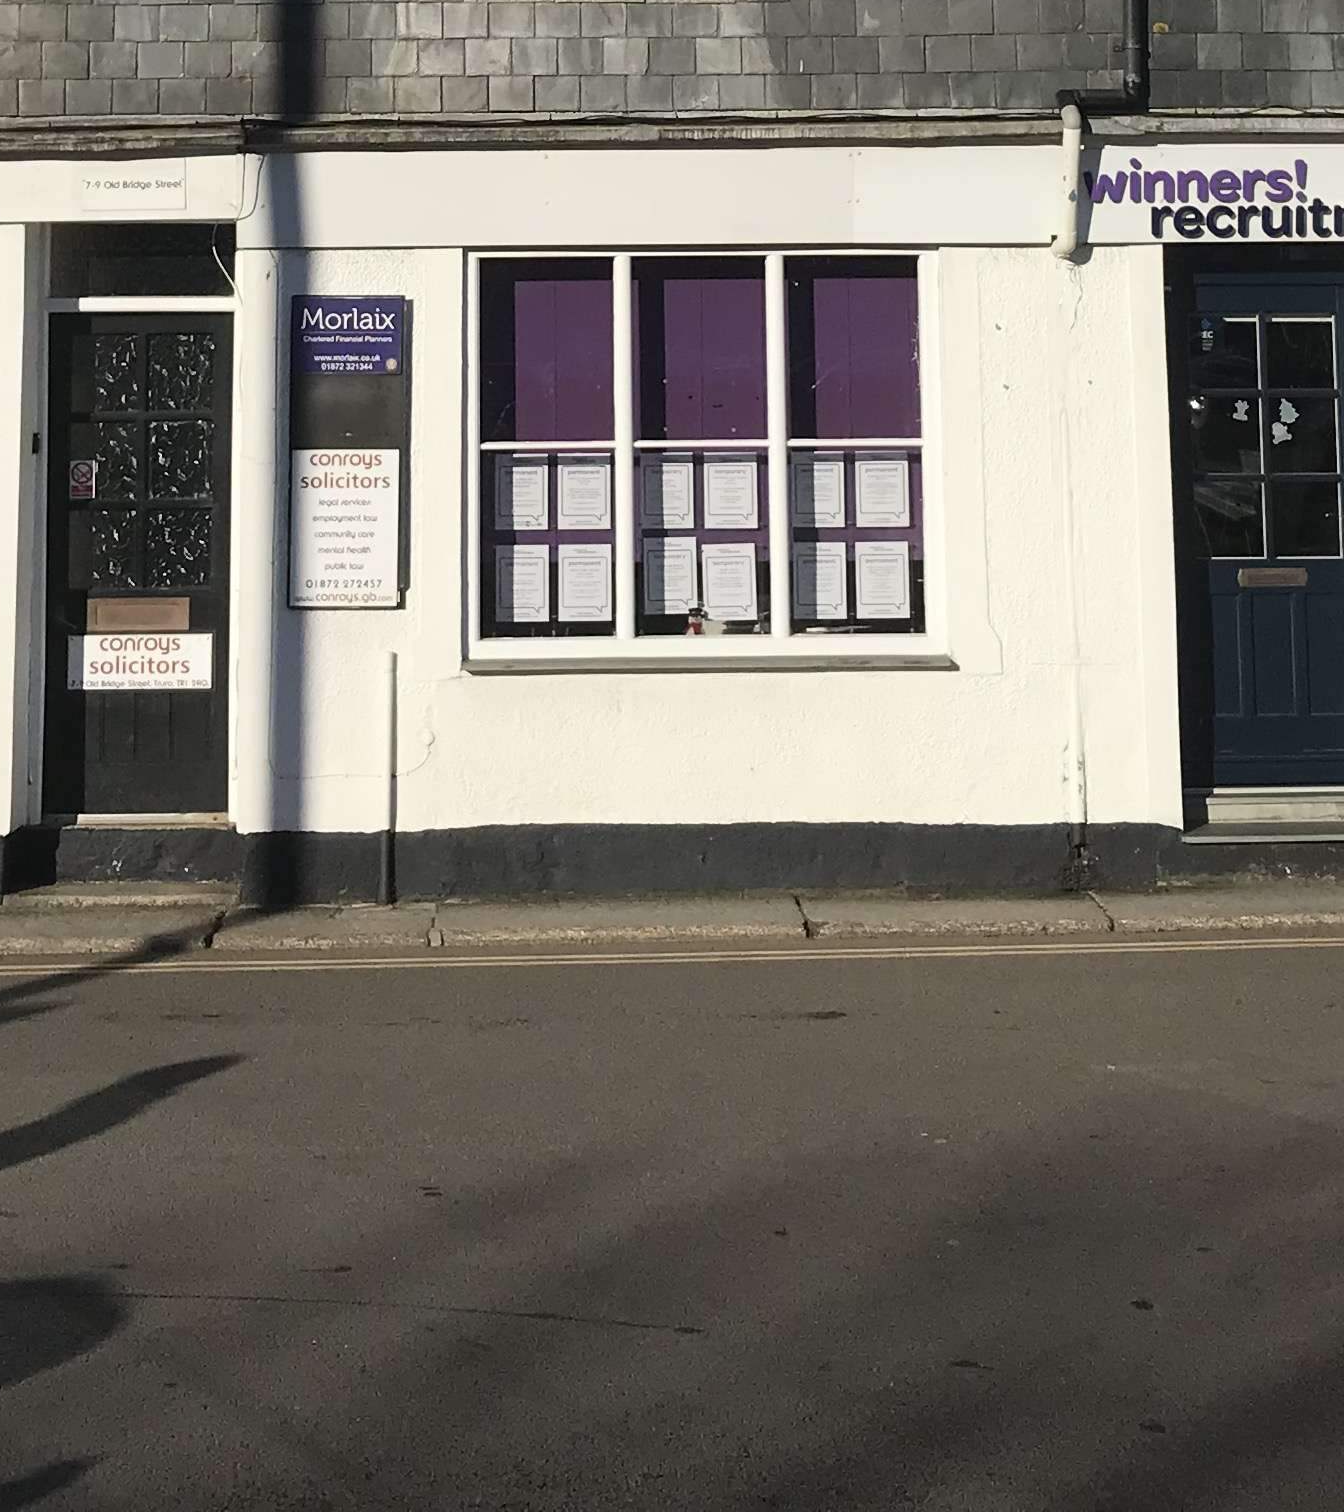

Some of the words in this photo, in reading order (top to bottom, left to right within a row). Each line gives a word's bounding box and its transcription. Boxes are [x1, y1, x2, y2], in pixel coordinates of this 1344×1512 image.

[103, 180, 120, 189] Old
[122, 180, 152, 190] Bridge
[155, 180, 182, 189] Street
[1083, 158, 1308, 204] winners!
[301, 307, 396, 330] Morlaix
[309, 453, 383, 469] conroys
[300, 471, 391, 489] solicitors
[318, 498, 339, 507] legal
[312, 514, 361, 522] employment
[314, 530, 355, 538] community
[324, 562, 346, 570] public
[305, 579, 340, 588] 01872
[343, 579, 383, 588] 272457
[99, 637, 181, 655] conroys
[89, 656, 191, 674] solicitors
[101, 679, 125, 688] Bridge
